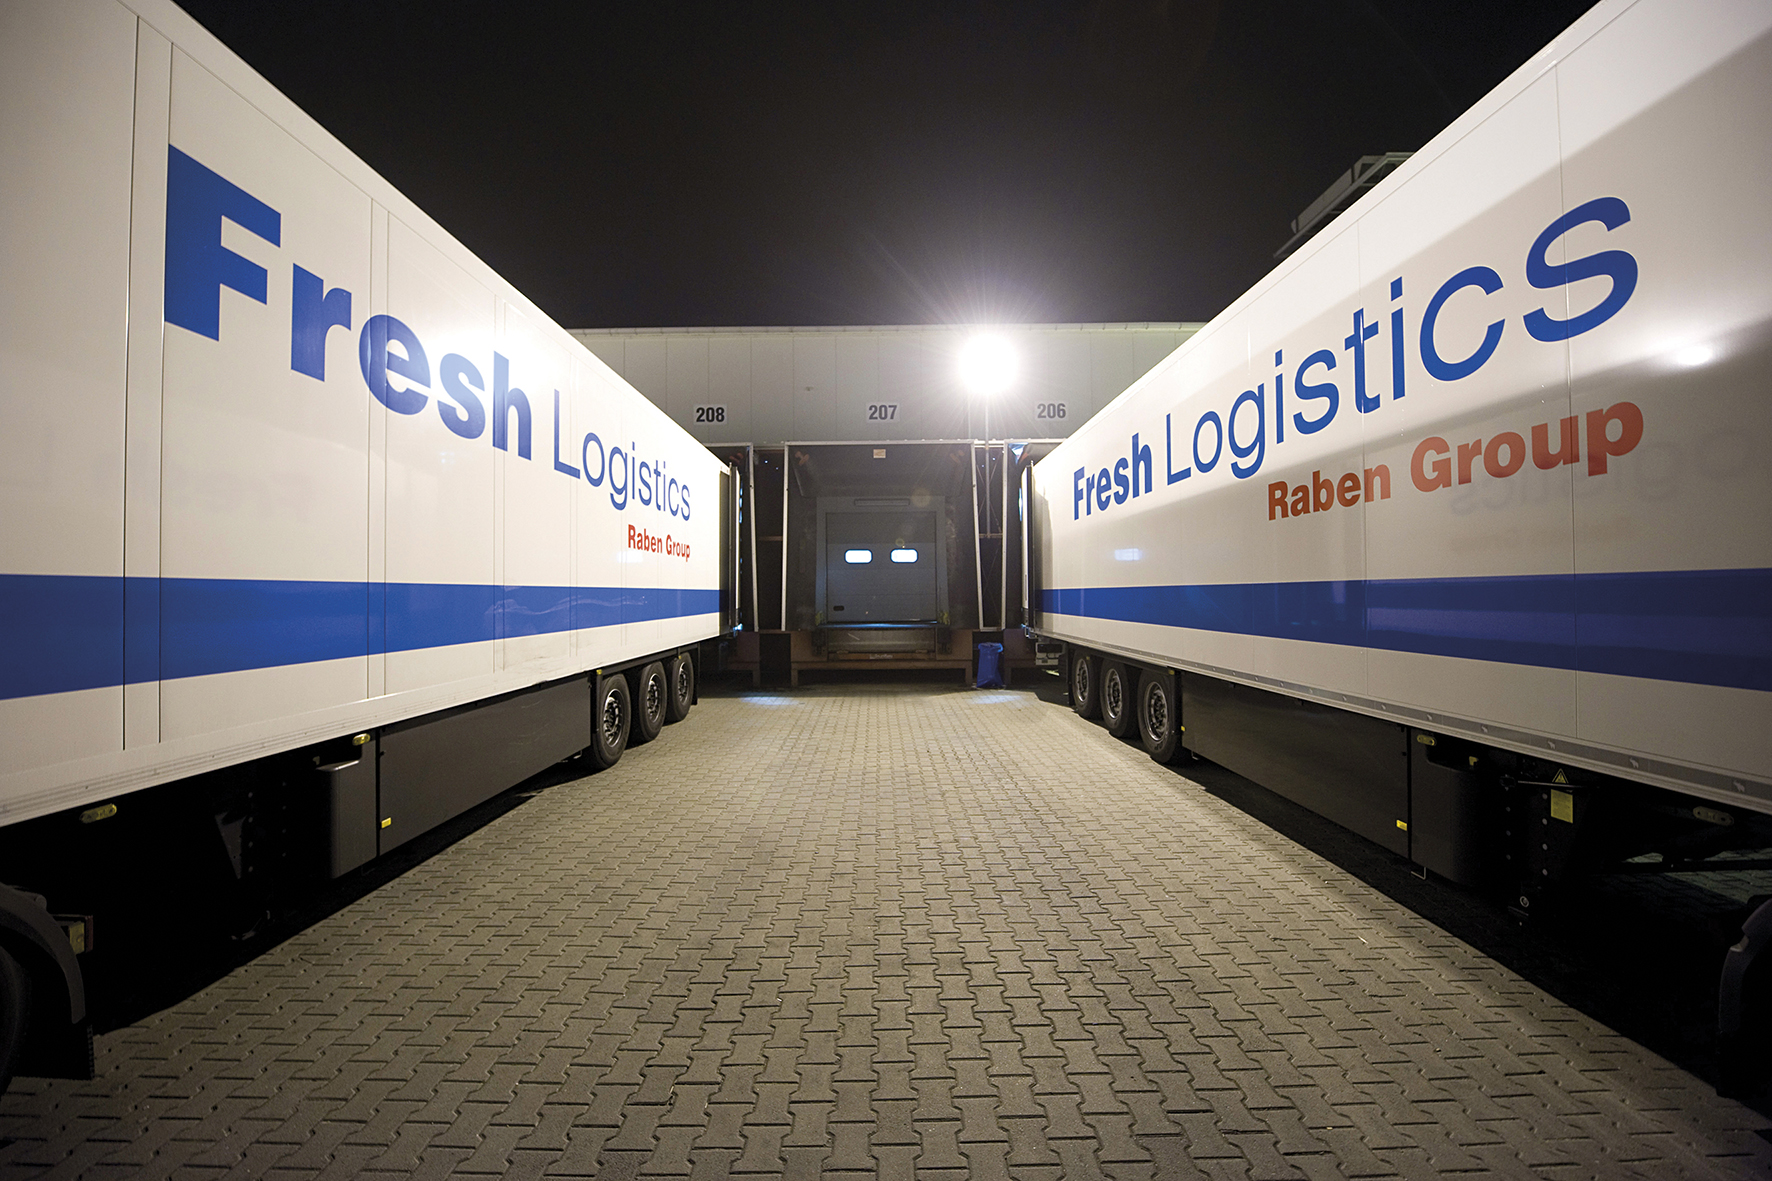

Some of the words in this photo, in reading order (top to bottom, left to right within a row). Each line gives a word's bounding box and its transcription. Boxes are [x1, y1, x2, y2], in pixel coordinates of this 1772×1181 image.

[164, 144, 531, 461] Fresh
[553, 389, 691, 522] Logistics
[1073, 431, 1153, 521] Fresh
[1165, 196, 1639, 486] Logistics
[695, 406, 726, 423] 208
[868, 404, 897, 420] 207
[1037, 403, 1066, 419] 206
[1267, 463, 1391, 522] Raben
[1410, 401, 1644, 492] Group
[627, 523, 663, 554] Raben
[665, 534, 691, 563] Group
